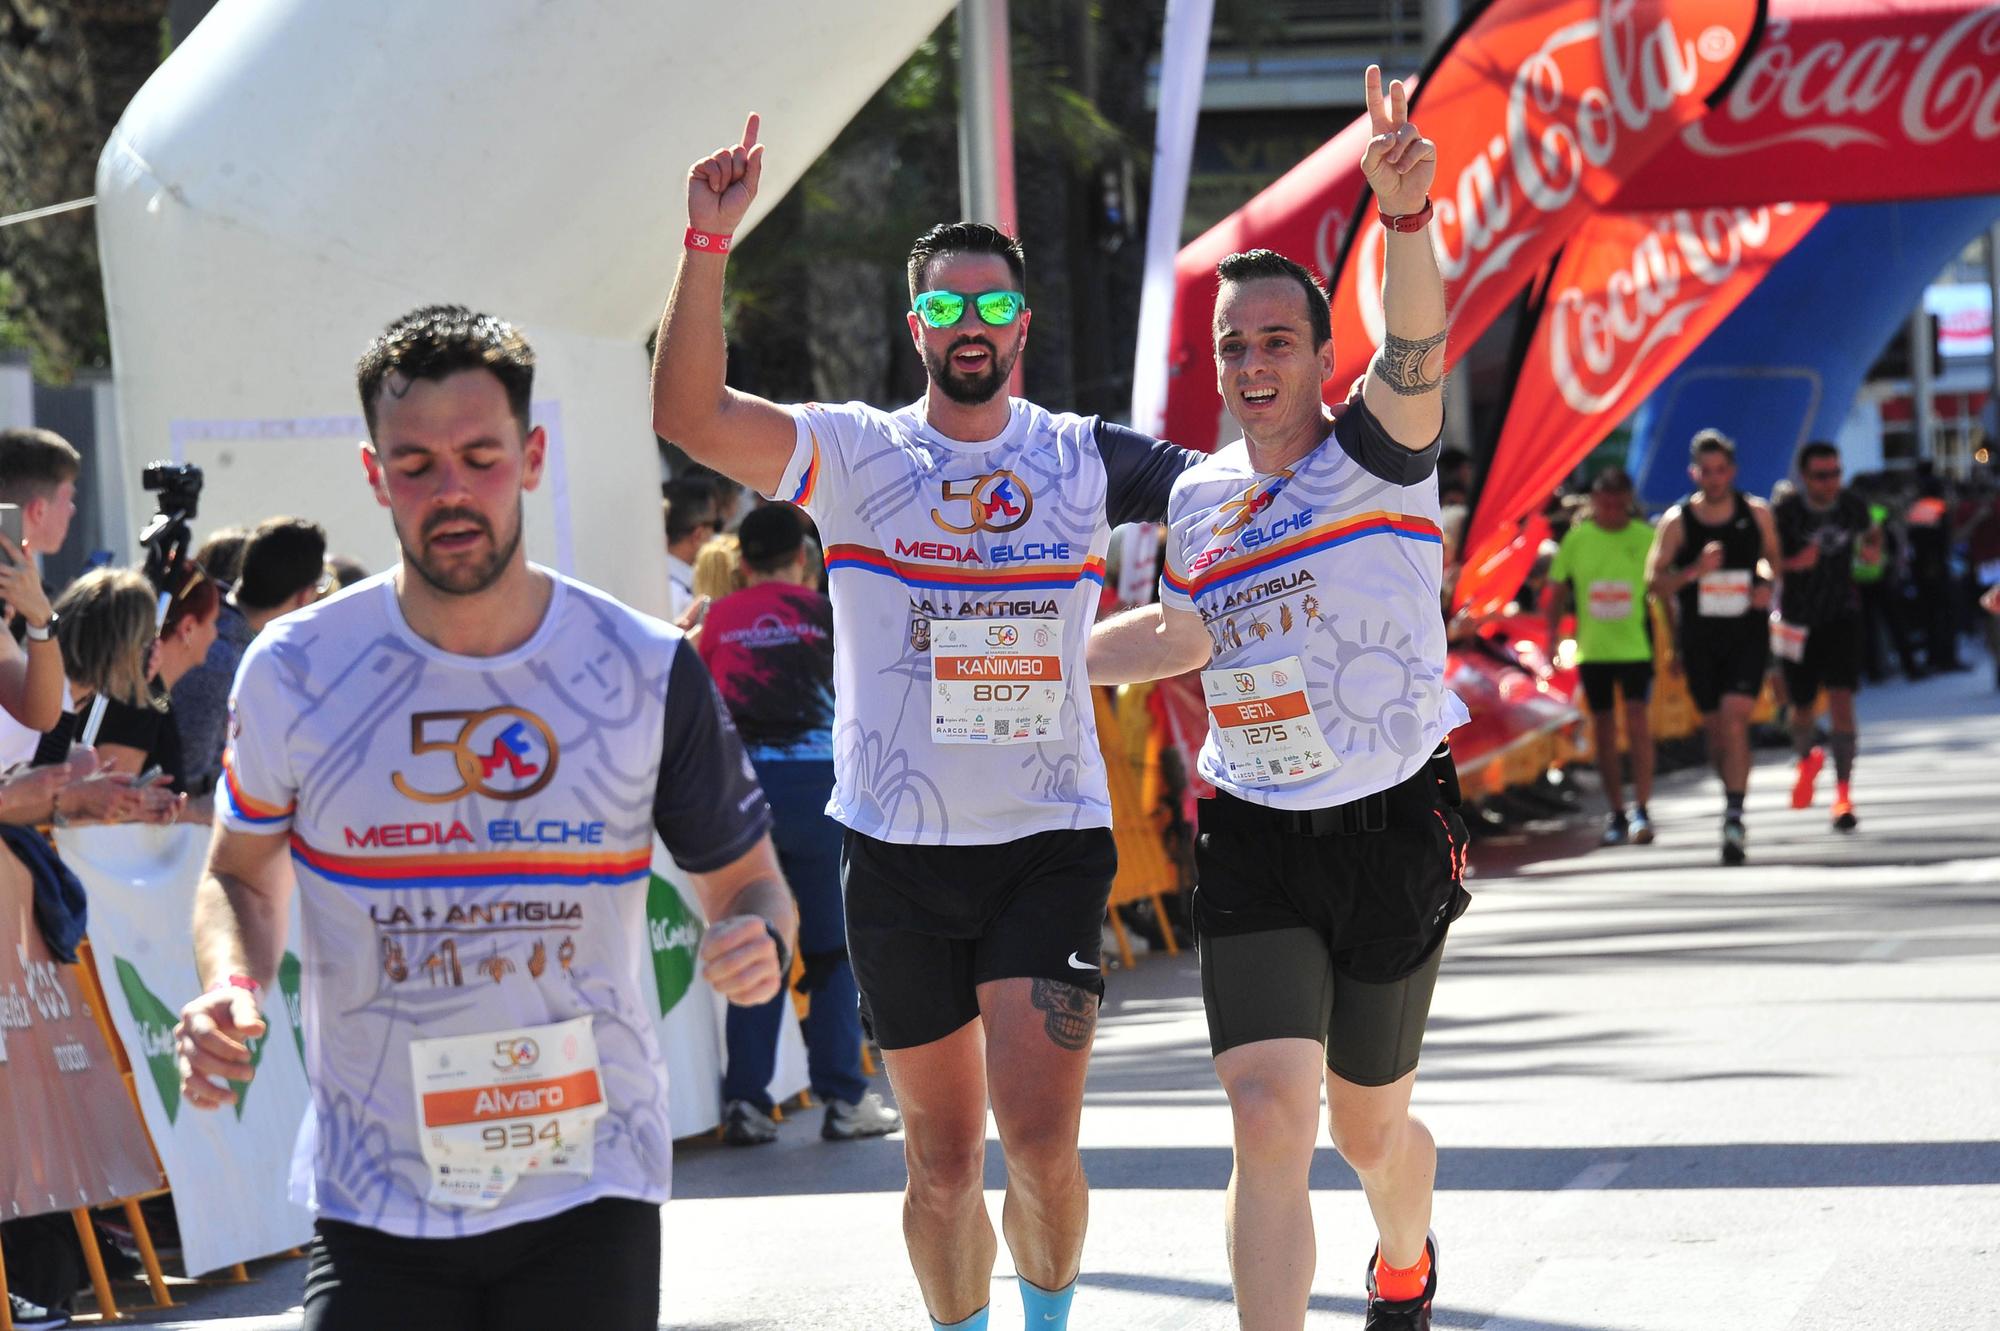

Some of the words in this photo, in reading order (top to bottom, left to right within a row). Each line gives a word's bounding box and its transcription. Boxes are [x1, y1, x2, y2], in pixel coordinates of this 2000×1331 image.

[930, 469, 1034, 535] 50
[1240, 508, 1313, 548] ELCHE
[895, 537, 983, 564] MEDIA
[990, 542, 1070, 564] ELCHE
[1222, 569, 1315, 610] ANTIGUA
[958, 599, 1060, 617] ANTIGUA
[957, 655, 1043, 676] KAÑIMBO
[973, 684, 1031, 702] 807
[1237, 701, 1276, 721] BETA
[1242, 724, 1288, 745] 1275
[391, 704, 561, 804] 50
[343, 819, 475, 849] MEDIA
[487, 818, 606, 844] ELCHE
[370, 904, 413, 925] LA
[445, 901, 583, 925] ANTIGUA
[474, 1085, 564, 1115] Alvaro
[481, 1119, 561, 1151] 934
